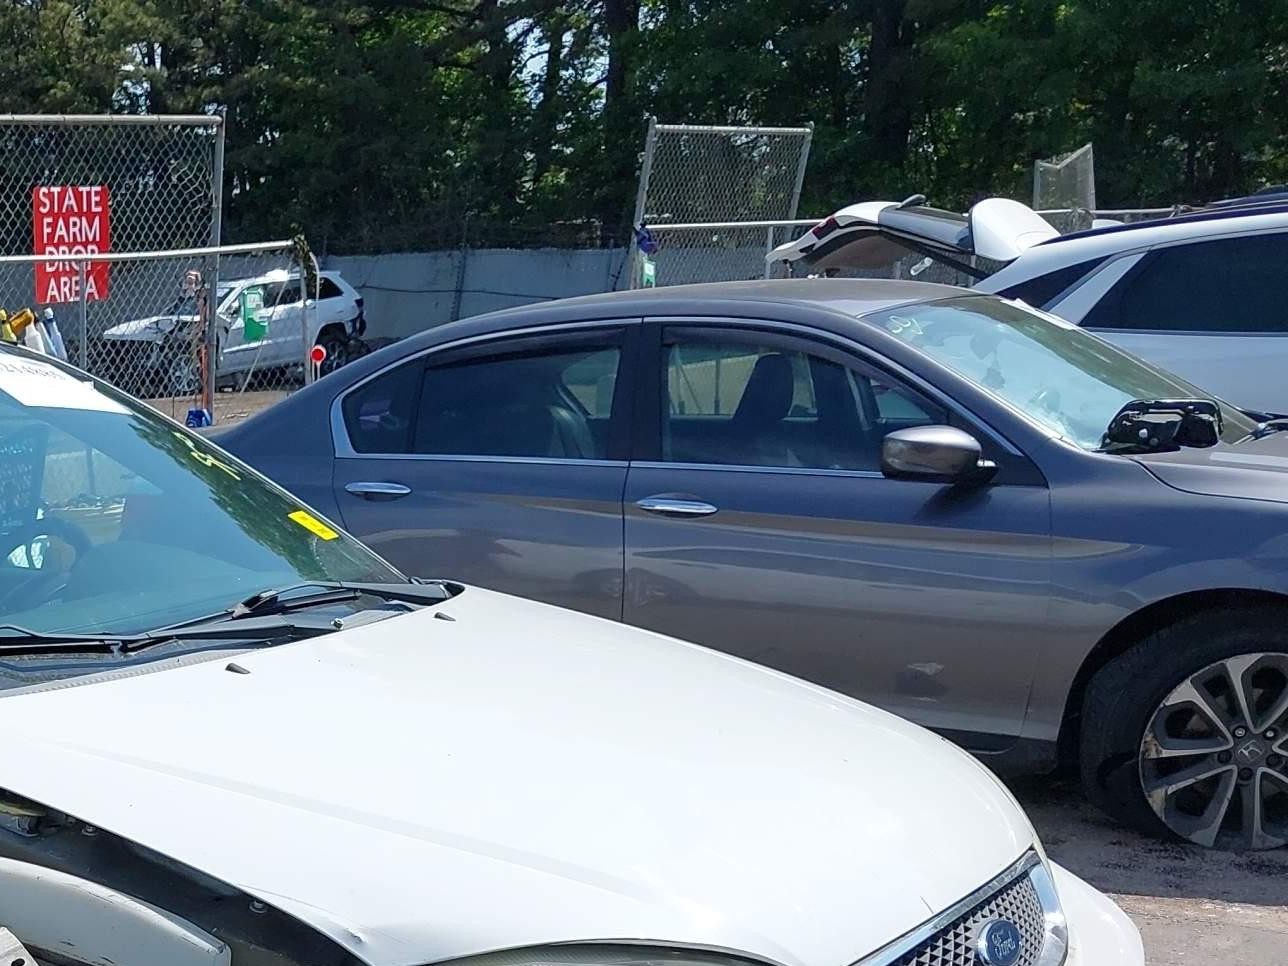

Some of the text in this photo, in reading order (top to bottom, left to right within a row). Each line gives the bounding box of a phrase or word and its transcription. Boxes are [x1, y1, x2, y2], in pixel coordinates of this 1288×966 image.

[39, 186, 102, 213] STATE
[43, 215, 100, 243] FARM
[45, 244, 99, 272] DROP
[46, 275, 99, 303] AREA
[992, 928, 1016, 960] Ford
